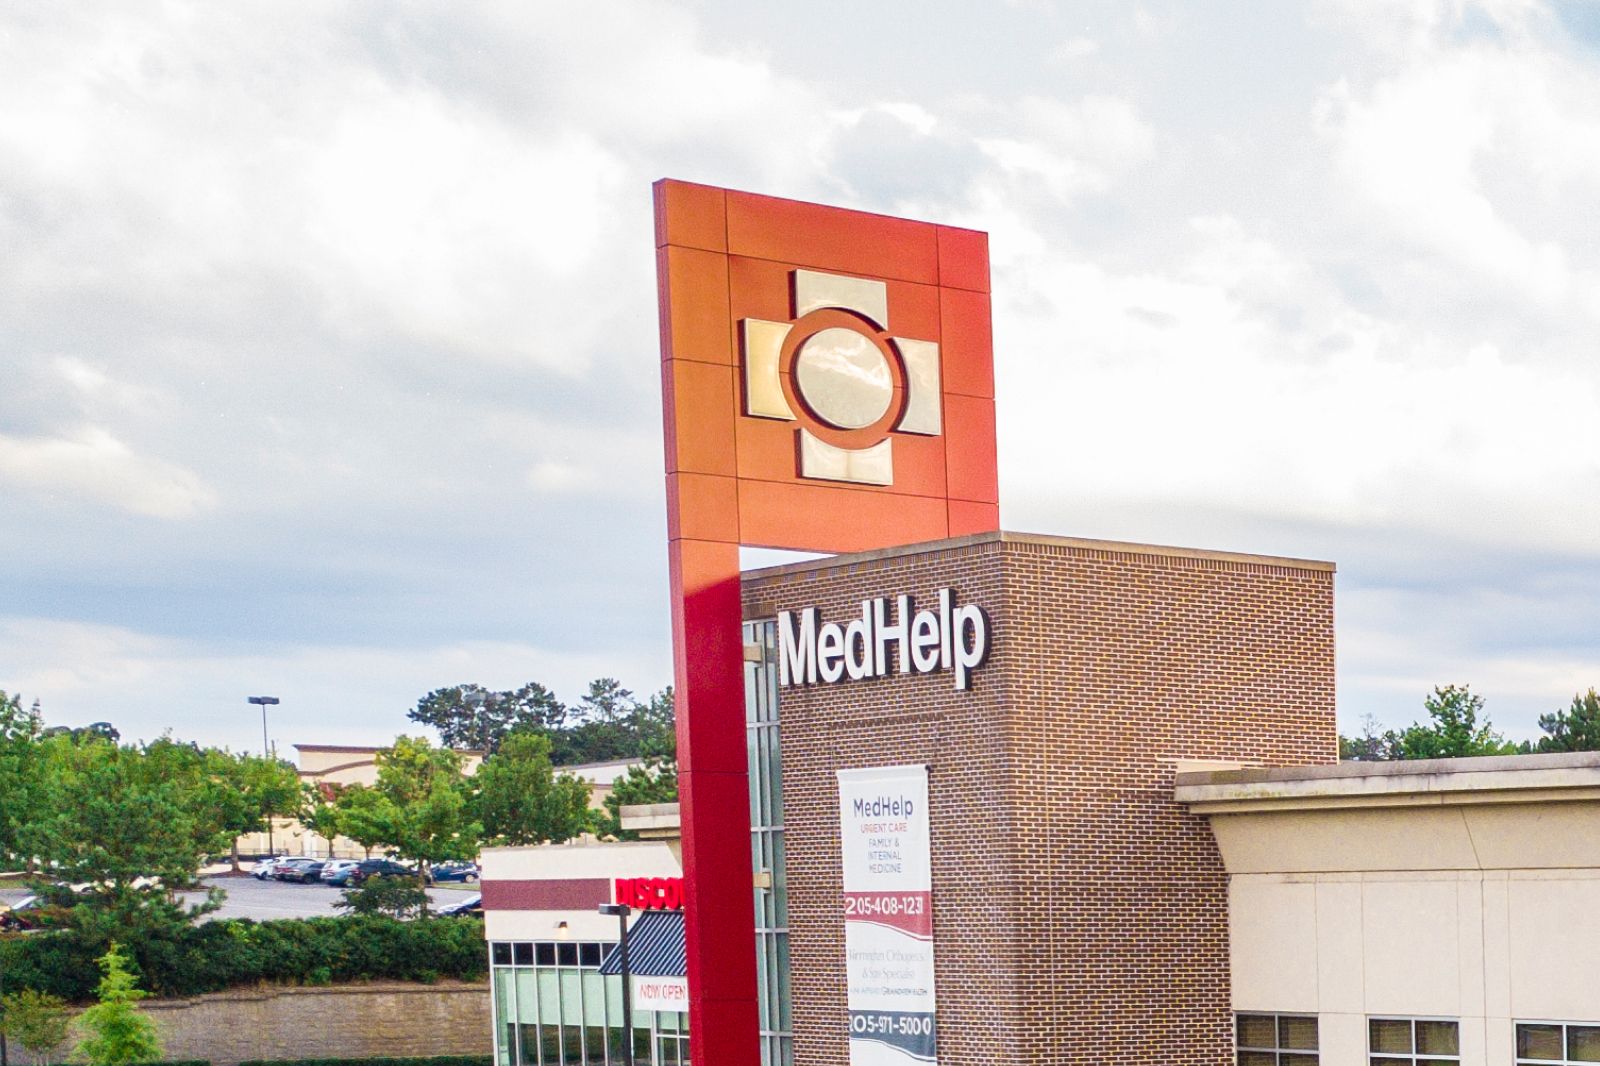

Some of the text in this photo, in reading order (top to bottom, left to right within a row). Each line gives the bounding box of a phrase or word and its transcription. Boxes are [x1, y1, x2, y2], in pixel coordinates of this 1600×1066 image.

[778, 588, 990, 691] MedHelp
[853, 795, 914, 819] MedHelp
[861, 822, 908, 833] URGENT CARE
[869, 838, 892, 848] FAMILY
[639, 984, 685, 1000] NOW OPEN
